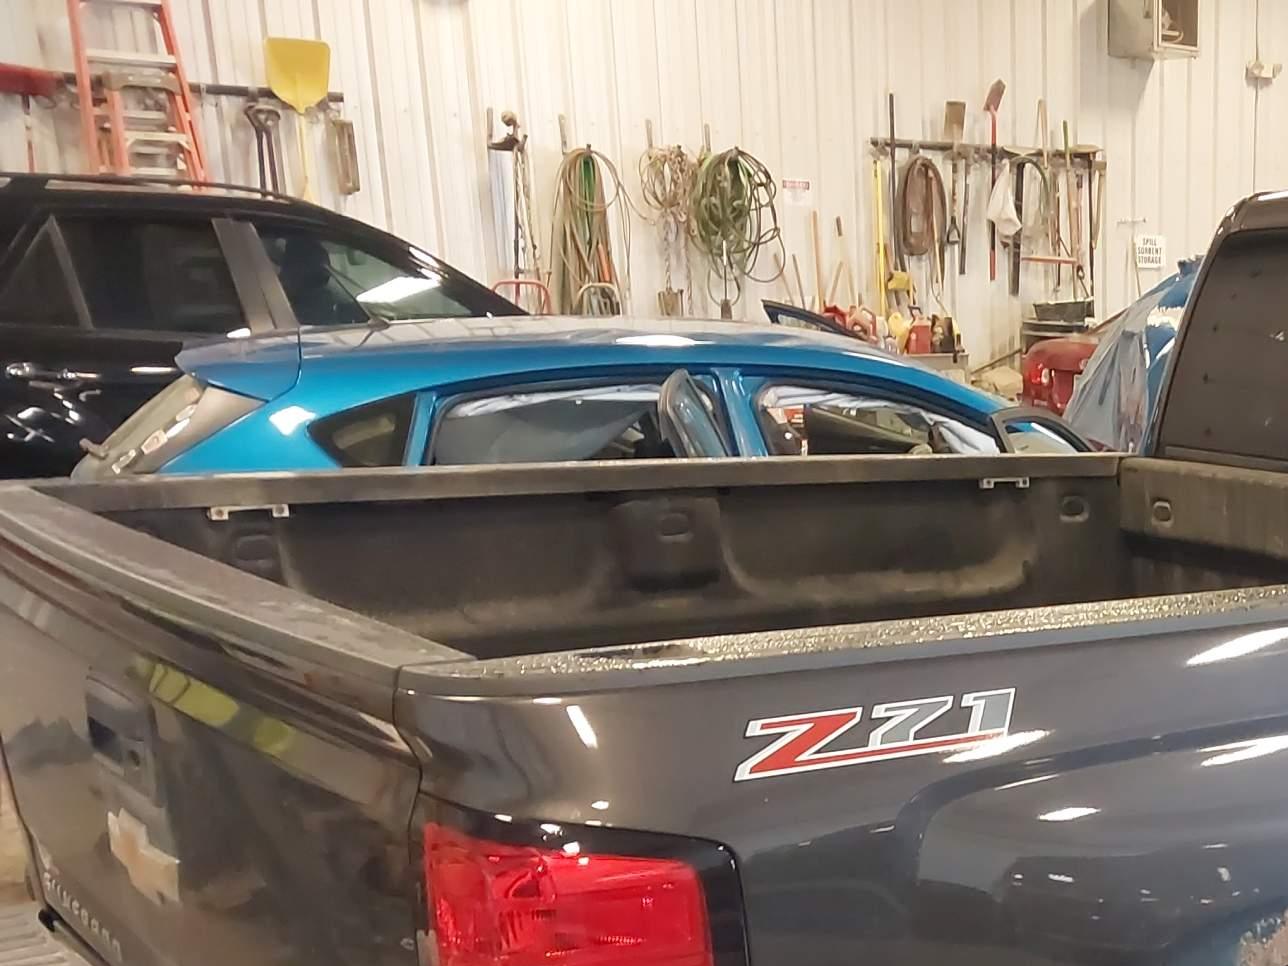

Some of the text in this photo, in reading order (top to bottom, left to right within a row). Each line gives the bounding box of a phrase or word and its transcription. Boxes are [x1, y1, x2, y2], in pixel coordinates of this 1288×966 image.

[1142, 237, 1157, 246] SPILL
[1138, 255, 1161, 264] STORAGE
[733, 687, 1016, 782] Z71
